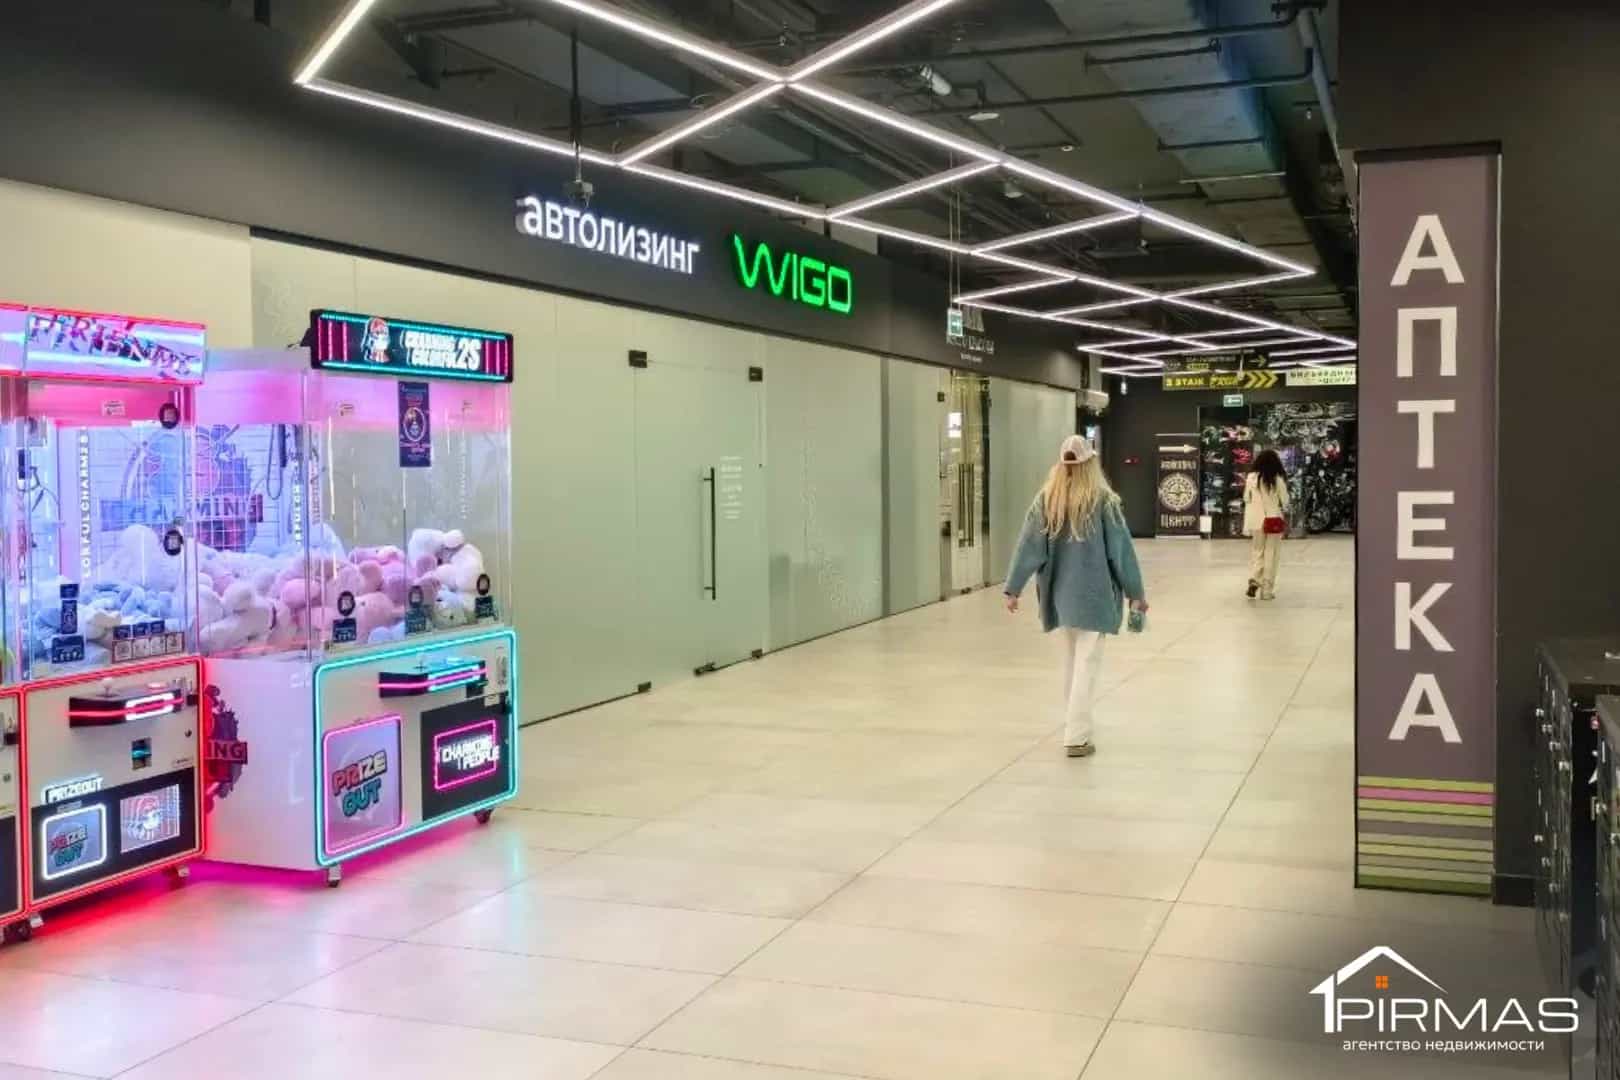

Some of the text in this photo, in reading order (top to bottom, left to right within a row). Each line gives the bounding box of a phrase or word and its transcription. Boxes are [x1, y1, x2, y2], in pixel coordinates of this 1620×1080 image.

[517, 196, 700, 274] автолизинг
[734, 233, 851, 314] WIGO
[1389, 214, 1465, 743] АПТЕКА
[332, 750, 387, 796] PRIZE
[342, 779, 382, 817] OUT
